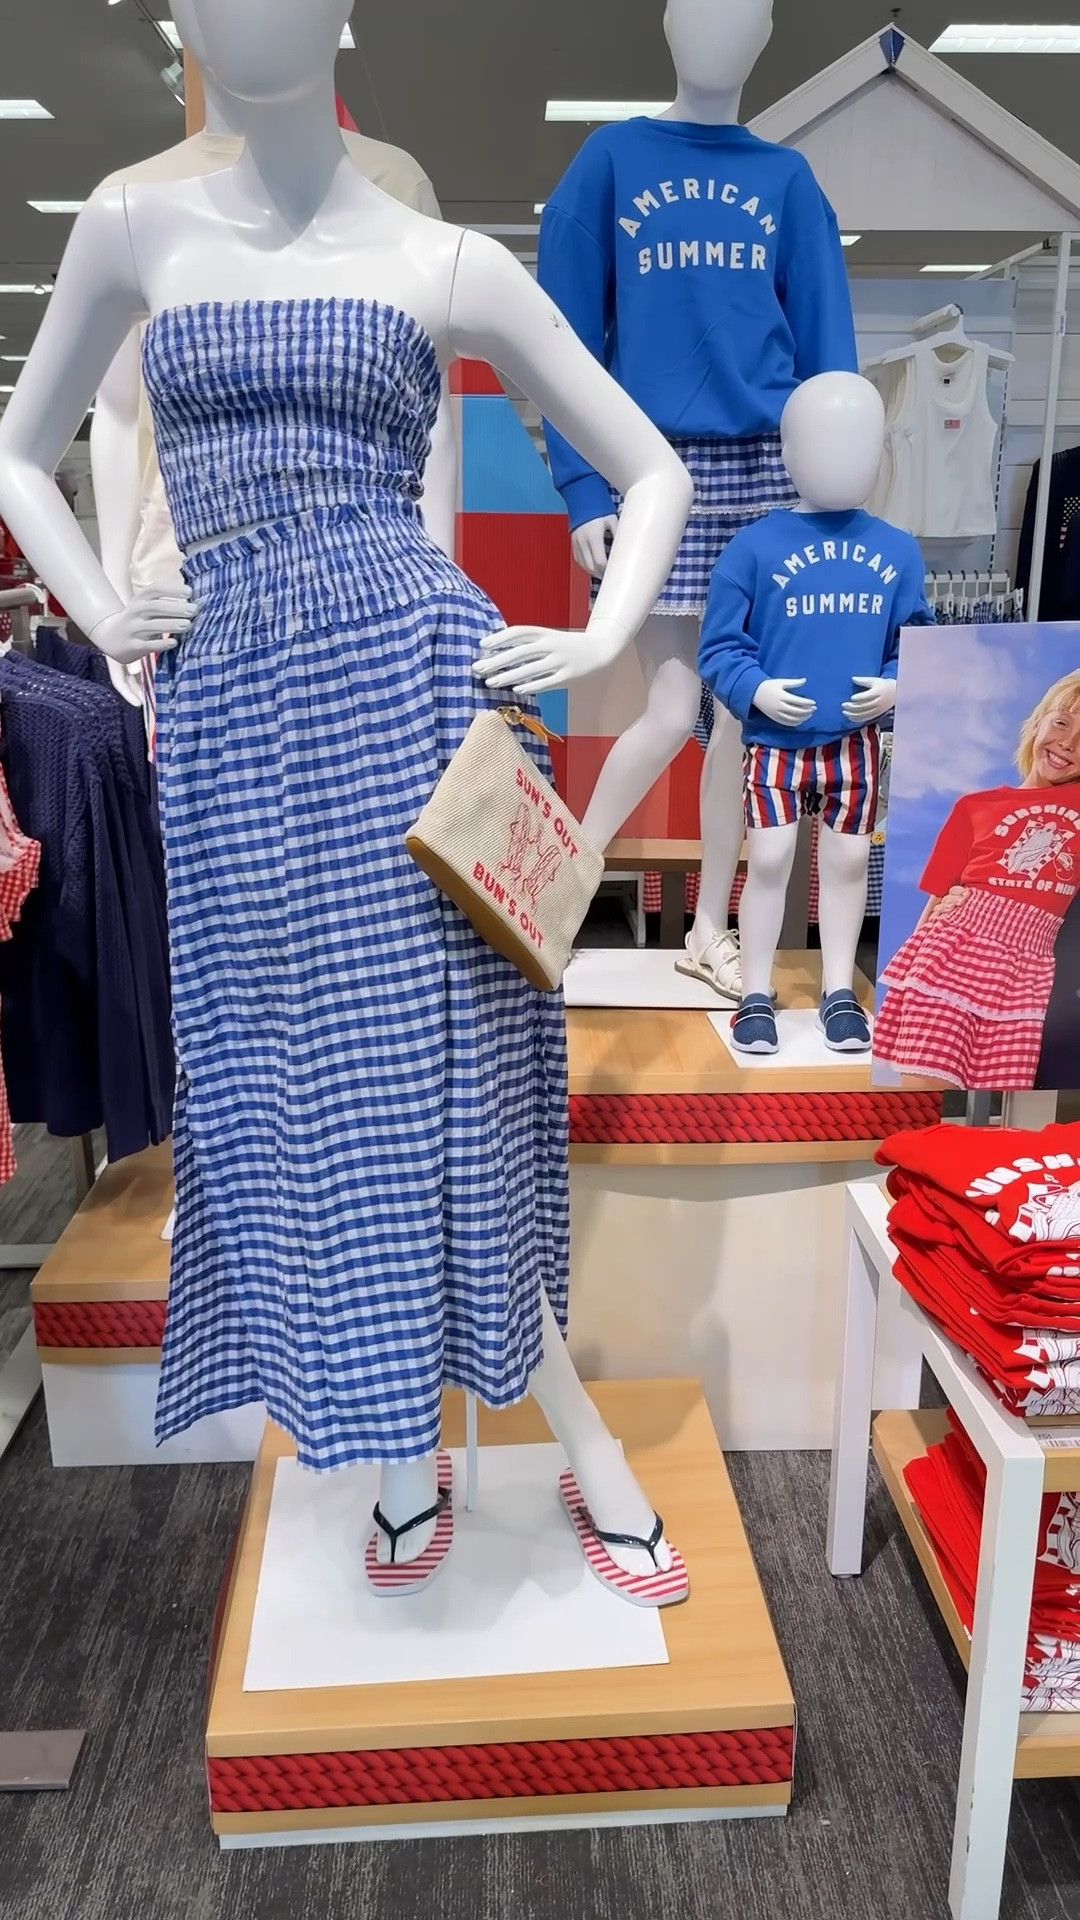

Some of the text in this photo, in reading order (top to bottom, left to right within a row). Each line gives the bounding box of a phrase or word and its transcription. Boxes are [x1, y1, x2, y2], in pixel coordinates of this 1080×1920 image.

[618, 178, 776, 239] AMERICAN
[638, 240, 767, 275] SUMMER
[771, 540, 898, 590] AMERICAN
[786, 593, 884, 618] SUMMER
[516, 767, 579, 858] SUN'S OUT
[988, 877, 1033, 889] STATE
[1036, 879, 1054, 892] OF
[519, 911, 544, 949] OUT
[965, 1153, 1080, 1198] UNSH
